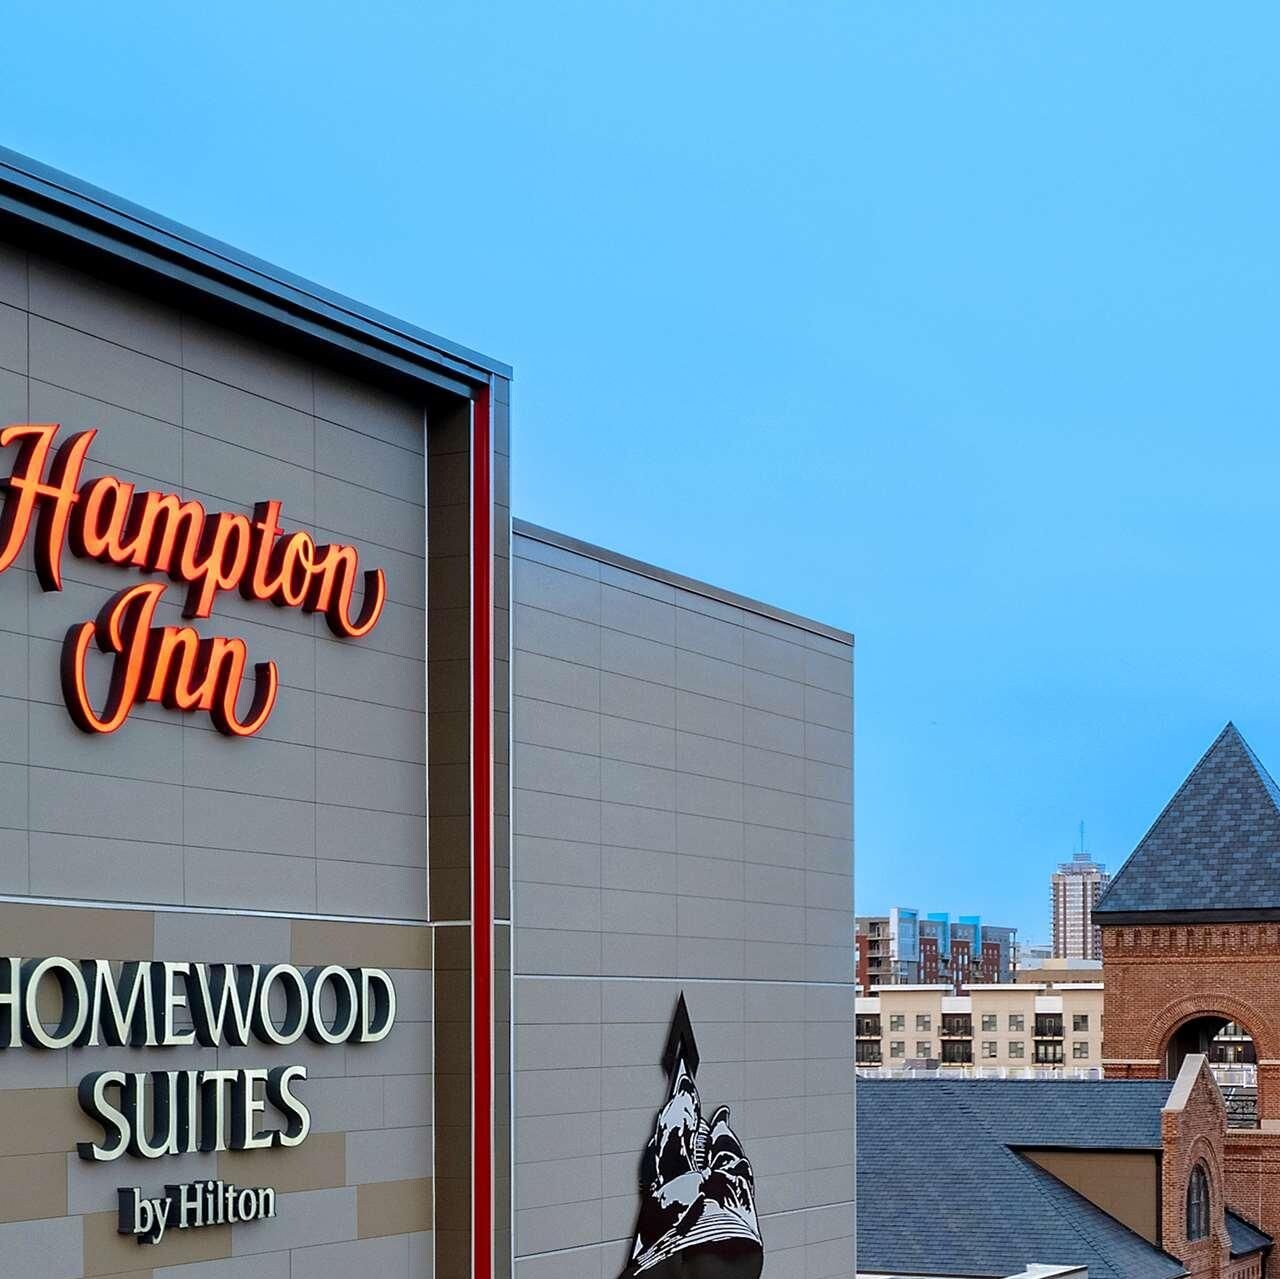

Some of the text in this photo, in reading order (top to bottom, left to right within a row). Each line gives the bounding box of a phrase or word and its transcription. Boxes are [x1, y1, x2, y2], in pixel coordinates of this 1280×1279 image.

[61, 582, 279, 736] Inn
[77, 1066, 312, 1161] SUITES
[123, 1180, 277, 1244] by Hilton
